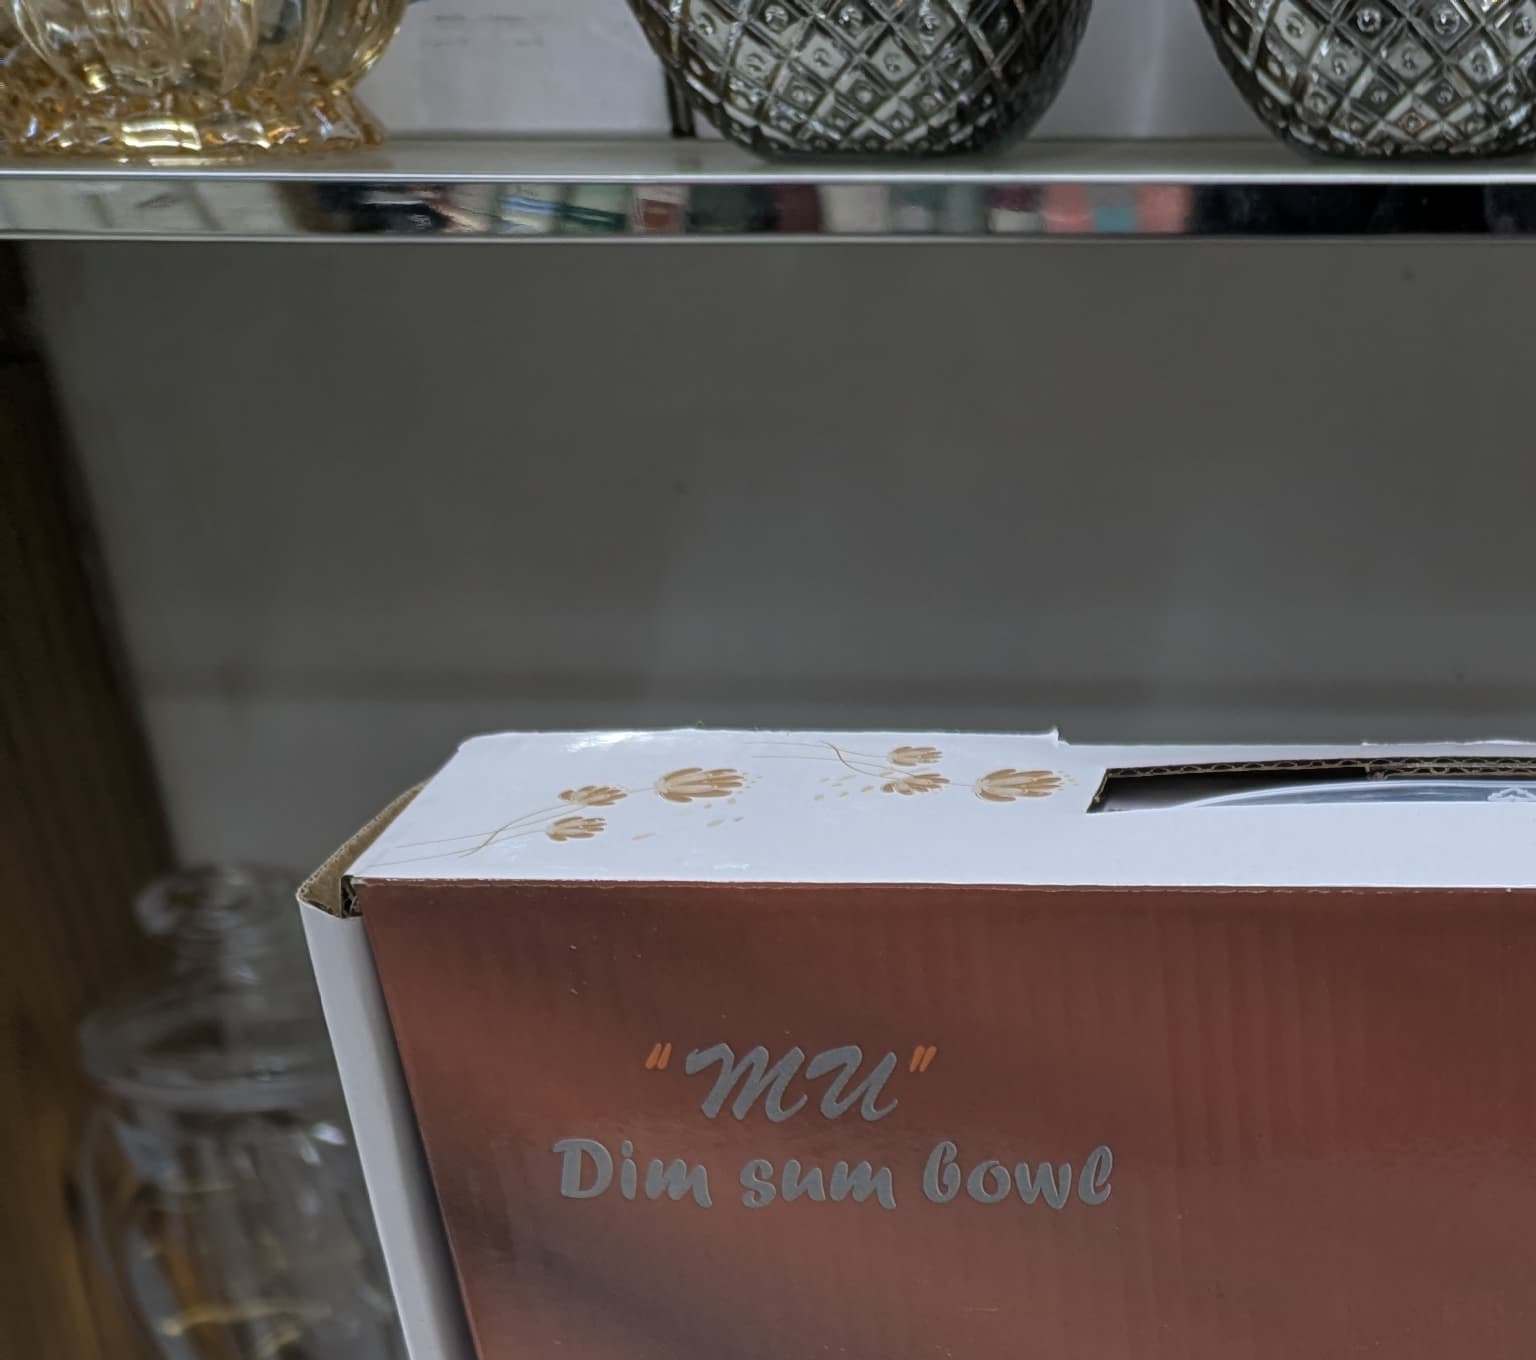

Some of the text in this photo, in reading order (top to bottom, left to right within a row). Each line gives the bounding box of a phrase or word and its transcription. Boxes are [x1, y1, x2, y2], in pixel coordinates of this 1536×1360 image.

[644, 1042, 938, 1122] "MU"
[553, 1138, 1114, 1209] Dim sum bowl
